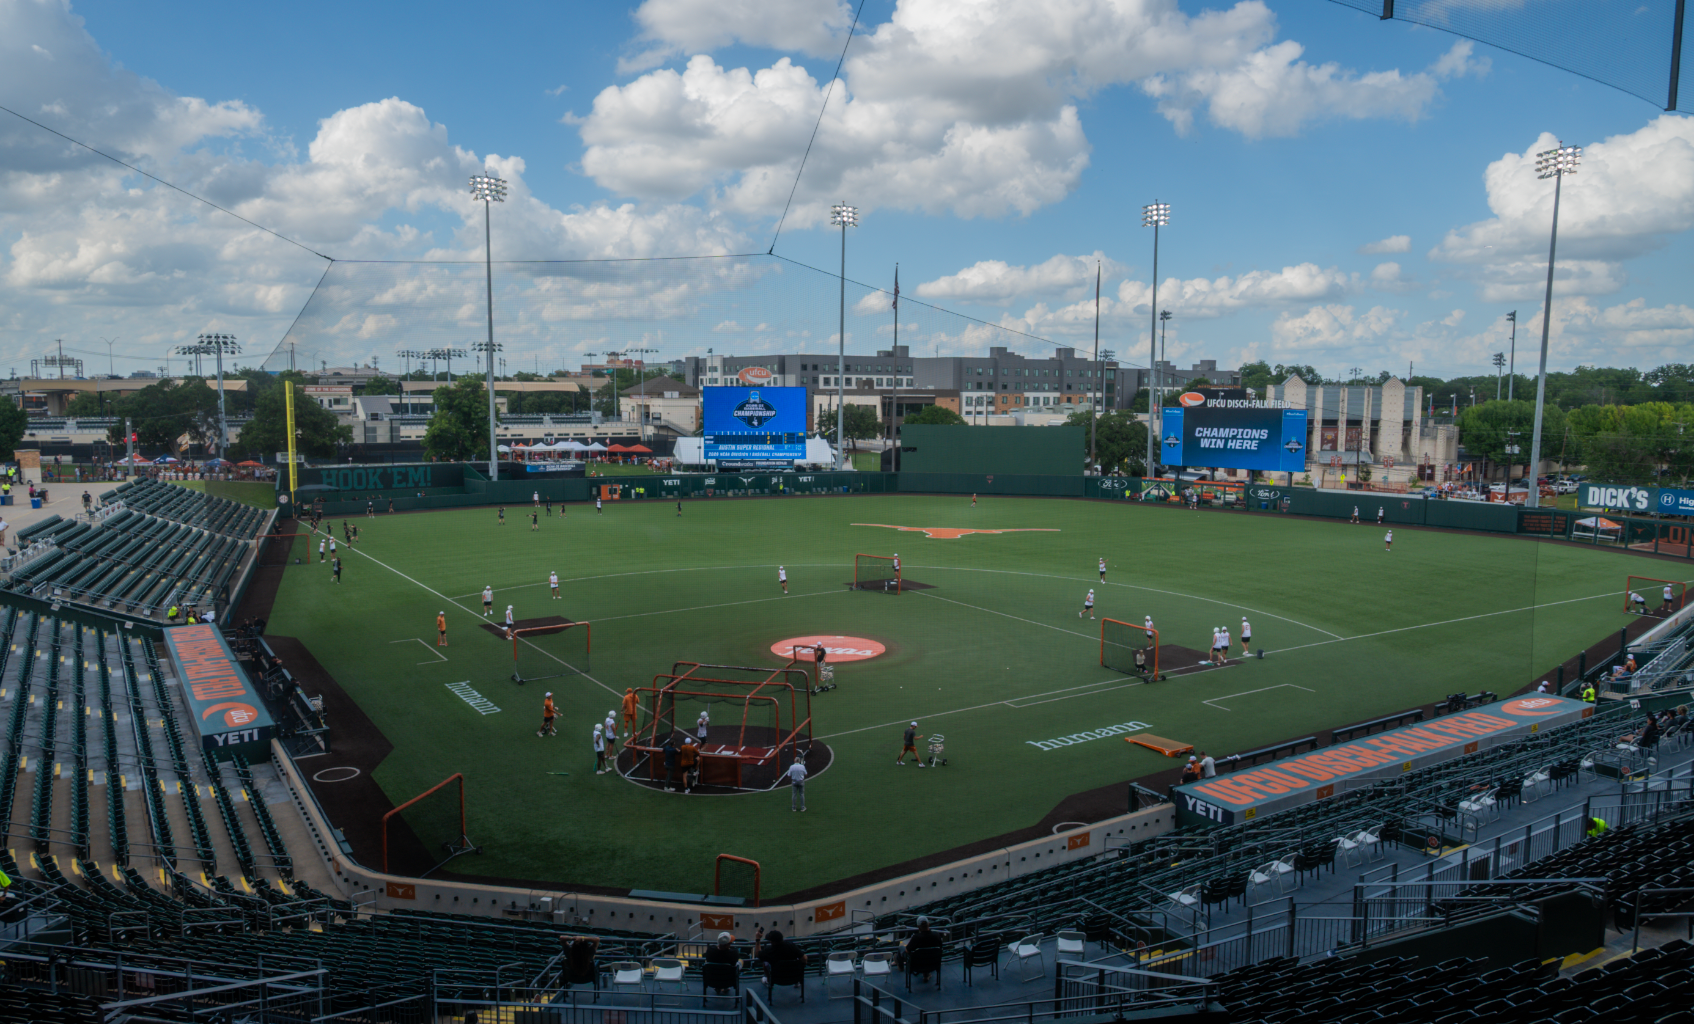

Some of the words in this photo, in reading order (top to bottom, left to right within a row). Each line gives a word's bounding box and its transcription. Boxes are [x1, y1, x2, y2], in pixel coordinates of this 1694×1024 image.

[1207, 398, 1226, 408] UFCU
[1227, 399, 1268, 408] DISCH-FALK
[1271, 400, 1290, 409] FIELD
[1195, 427, 1268, 439] CHAMPIONS
[1200, 438, 1224, 449] WIN
[1227, 439, 1259, 450] HERE
[320, 468, 384, 491] HOOK
[387, 466, 431, 488] 'EM!
[1588, 487, 1648, 509] DICK'S
[189, 676, 246, 700] FIELD
[444, 680, 501, 715] humann
[230, 709, 253, 724] ufcu
[213, 728, 259, 747] YETI
[1025, 720, 1153, 751] humann
[1193, 768, 1310, 805] UFCU
[1276, 727, 1463, 782] DISCH-FALK
[1424, 712, 1518, 738] FIELD
[1185, 795, 1222, 822] YETI
